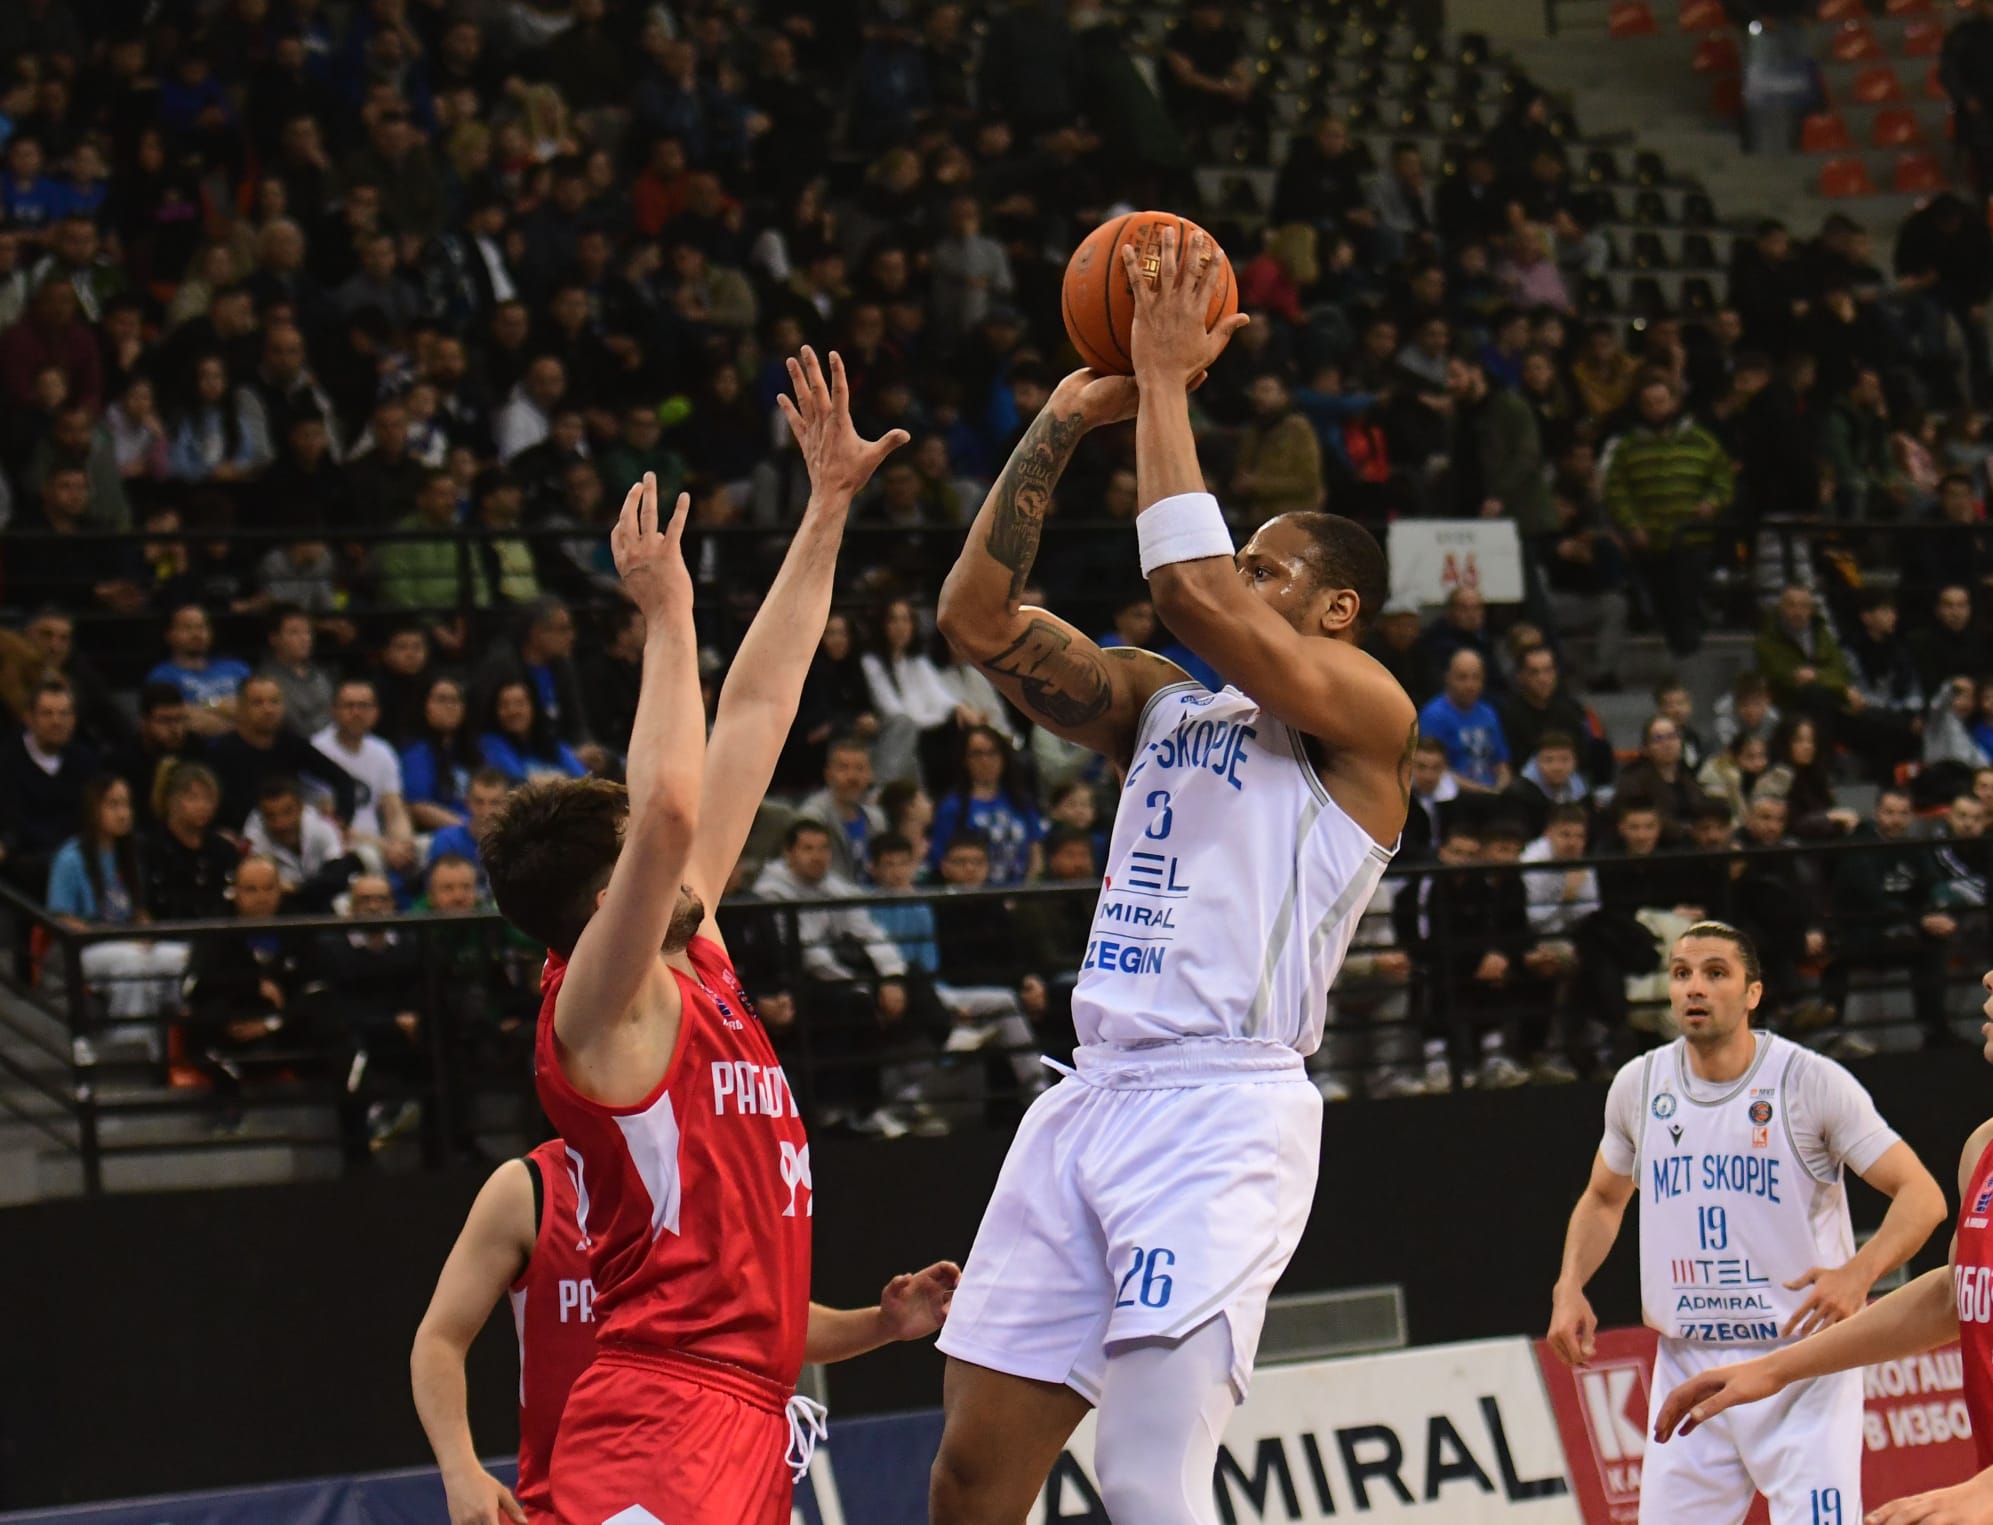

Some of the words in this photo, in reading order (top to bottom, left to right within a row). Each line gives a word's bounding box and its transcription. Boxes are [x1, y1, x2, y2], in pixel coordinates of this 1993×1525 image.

[1083, 940, 1166, 974] ZEGIN
[1653, 1155, 1693, 1204] MZT
[1702, 1154, 1781, 1204] SKOPJE
[1698, 1205, 1728, 1250] 19
[1115, 1246, 1176, 1308] 26
[1676, 1294, 1773, 1311] ADMIRAL
[1699, 1322, 1778, 1341] ZEGIN
[1044, 1395, 1569, 1525] AMIRAL
[1811, 1487, 1842, 1525] 19
